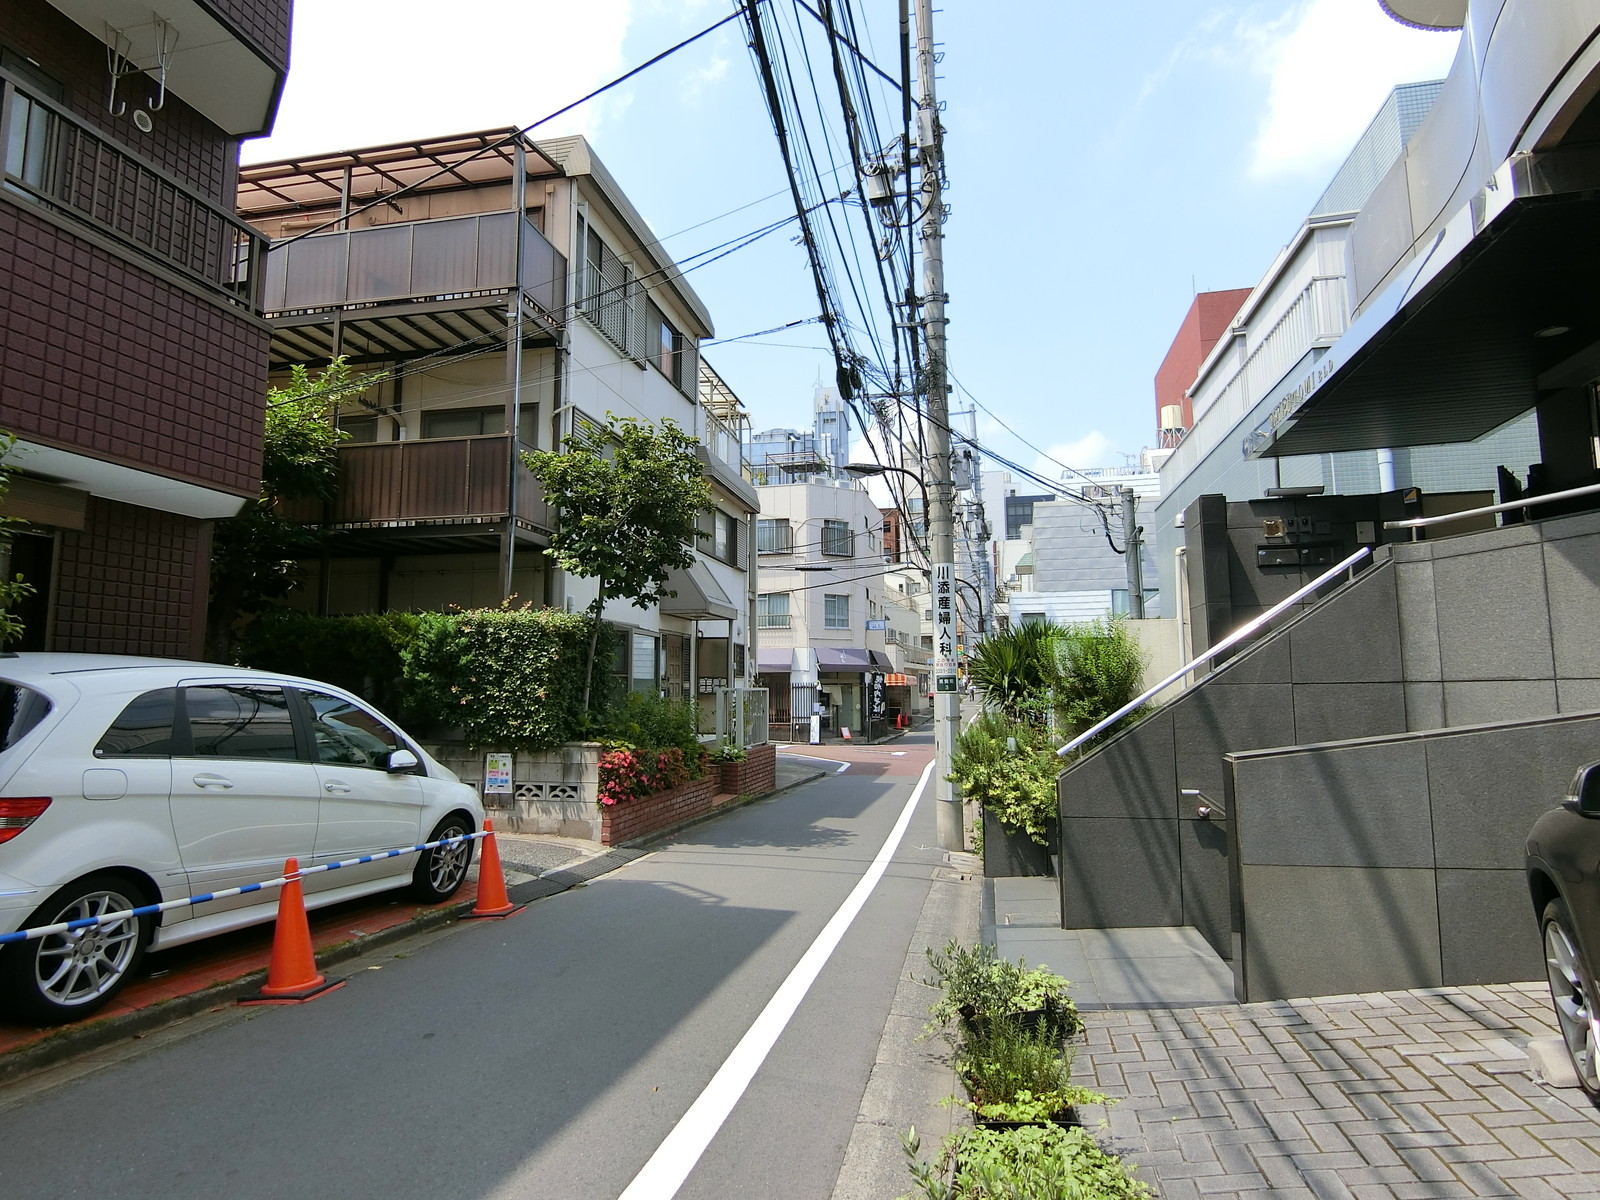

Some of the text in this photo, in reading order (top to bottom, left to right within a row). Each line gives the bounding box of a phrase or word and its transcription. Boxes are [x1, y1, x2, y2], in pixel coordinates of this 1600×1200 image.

[937, 566, 952, 656] 川添産婦人科
